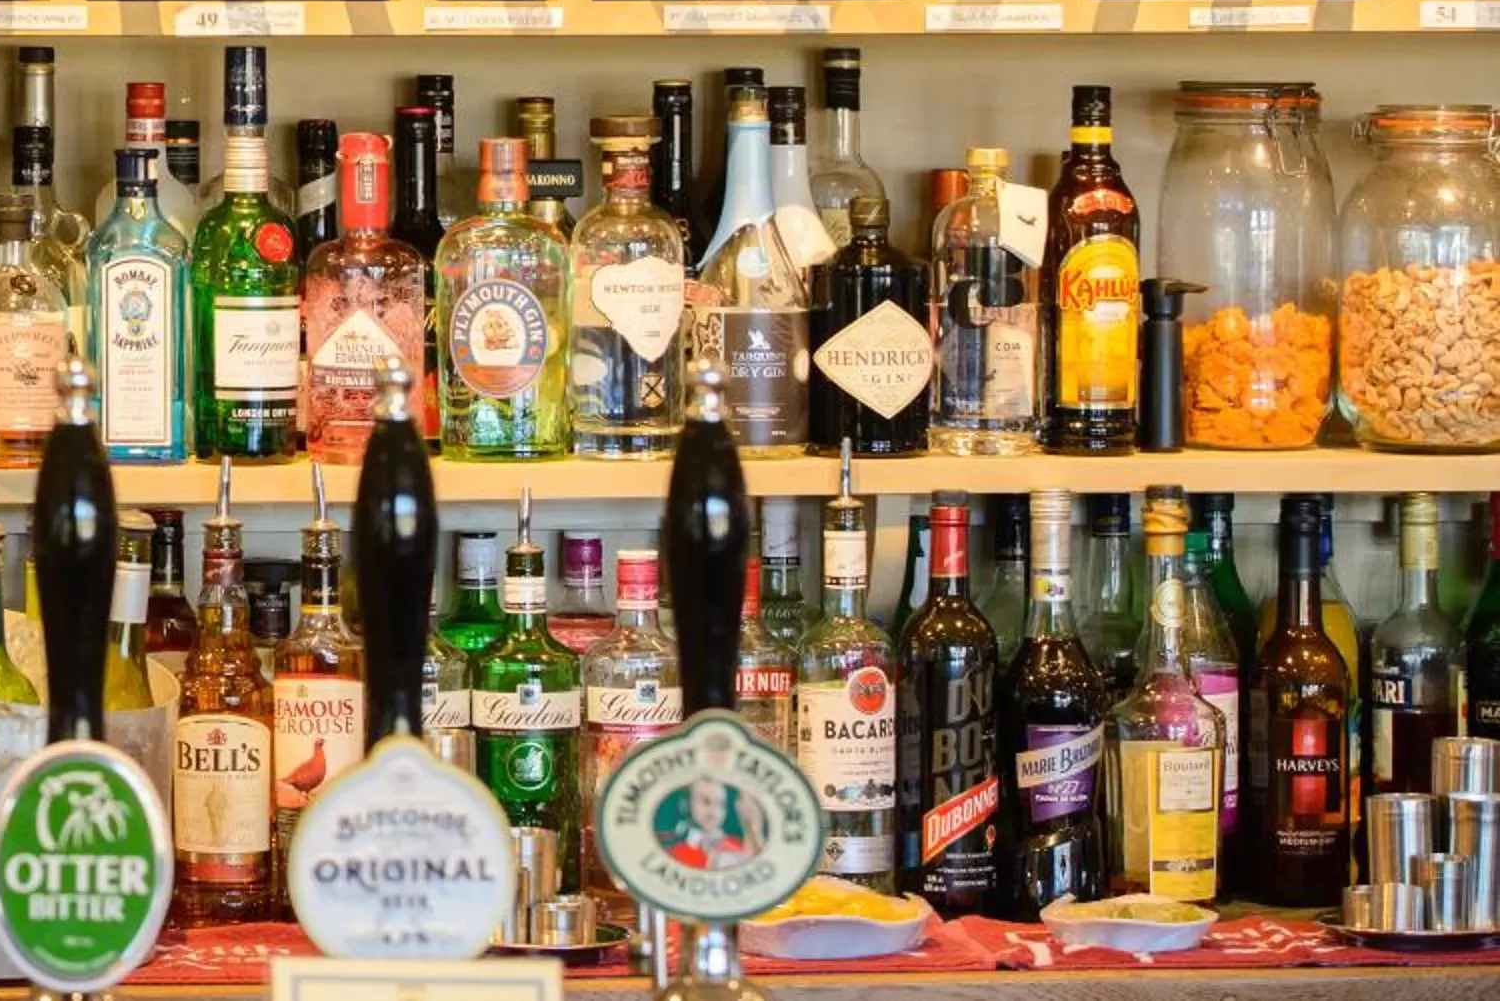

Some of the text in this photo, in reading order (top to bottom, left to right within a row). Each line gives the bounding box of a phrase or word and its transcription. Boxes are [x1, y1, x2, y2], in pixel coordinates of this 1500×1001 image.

[113, 270, 159, 288] BOMBAY
[454, 285, 545, 343] PLYMOUTH GIN
[113, 333, 159, 352] SAPPHIRE
[763, 366, 787, 378] GIN
[871, 374, 906, 384] GIN
[275, 698, 355, 719] FAMOUS
[176, 740, 262, 773] BELL'S
[1020, 756, 1058, 778] MARIE
[1276, 758, 1340, 773] HARVEYS
[616, 748, 698, 827] TIMOTHY
[4, 852, 150, 896] OTTER
[313, 857, 496, 893] ORIGINAL
[639, 850, 775, 898] LANDLORD
[28, 894, 126, 923] BITTER
